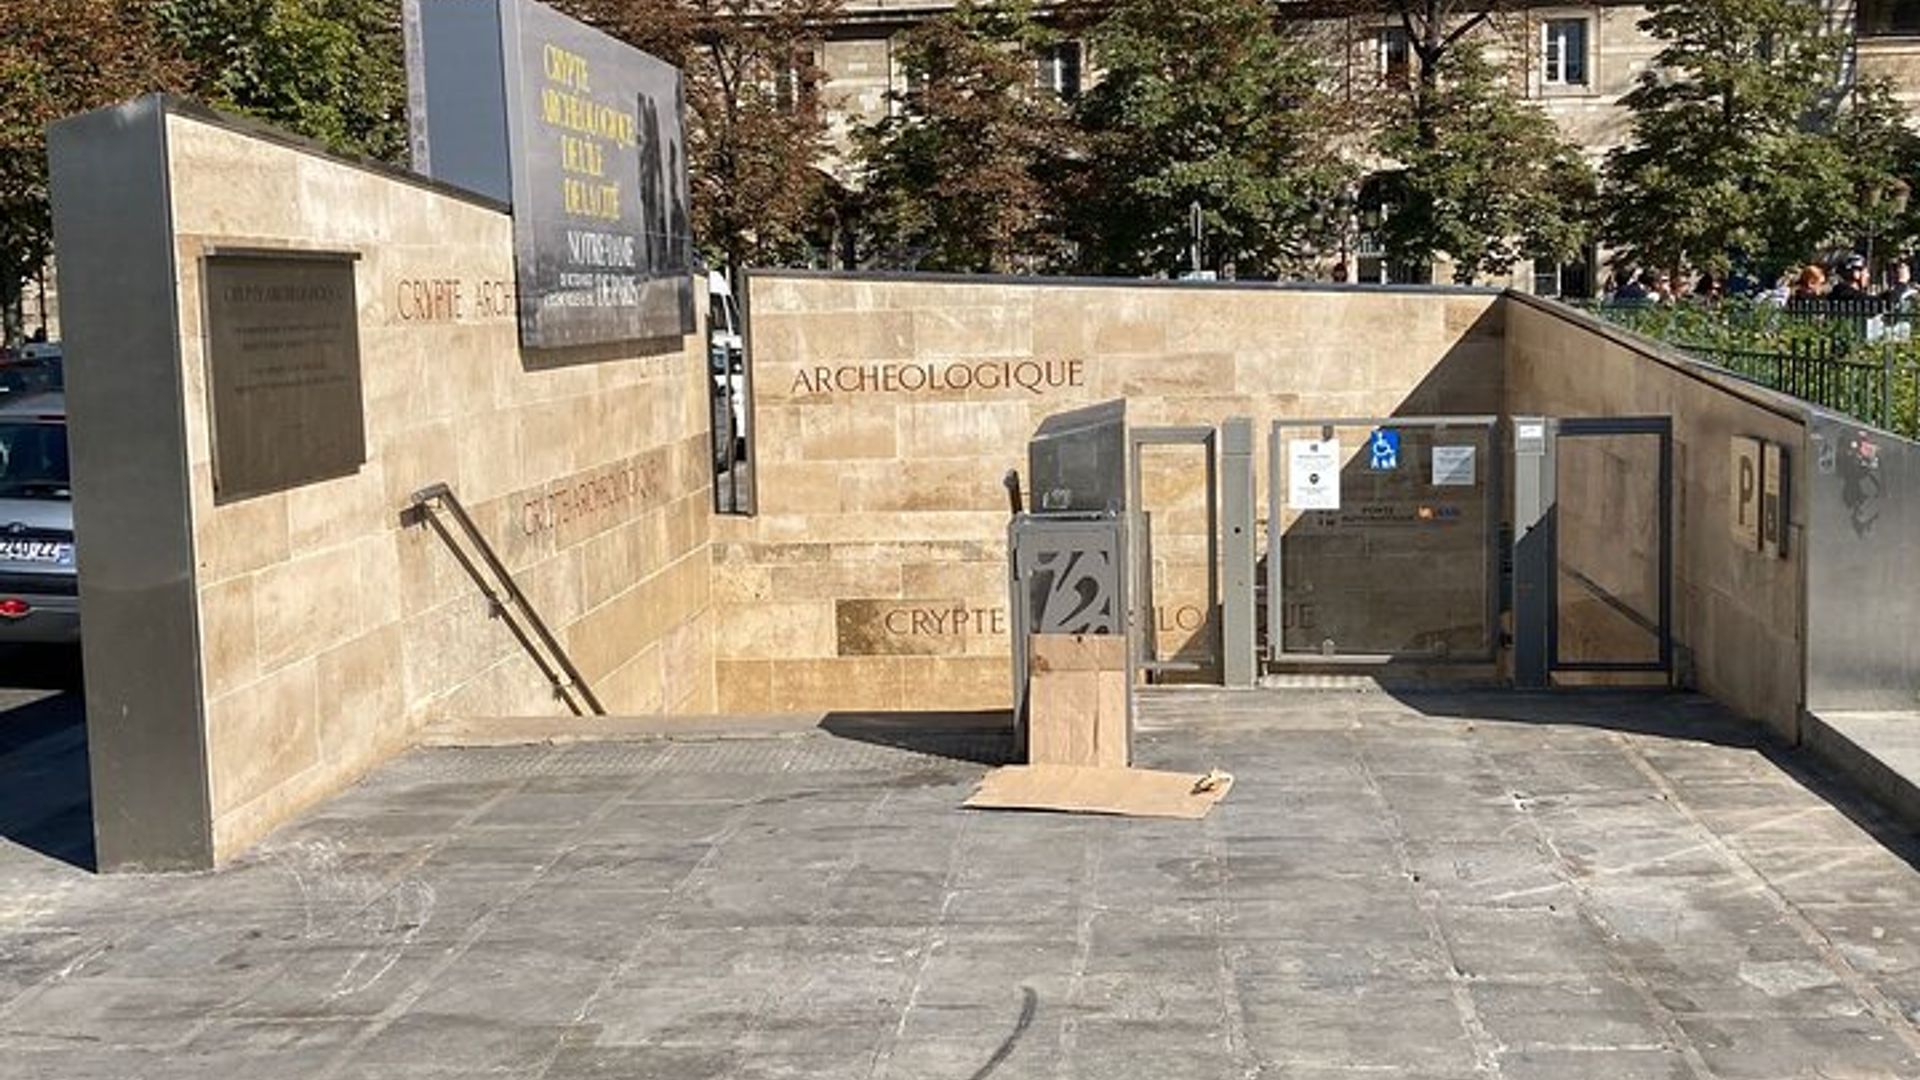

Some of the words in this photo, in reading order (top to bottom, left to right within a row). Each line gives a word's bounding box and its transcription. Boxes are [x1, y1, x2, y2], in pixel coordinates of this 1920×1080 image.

[543, 43, 590, 94] CRYPTE
[397, 279, 462, 321] CRYPTE
[789, 359, 1085, 395] ARCHEOLOGIQUE
[1739, 455, 1754, 525] P
[885, 608, 1007, 635] CRYPTE
